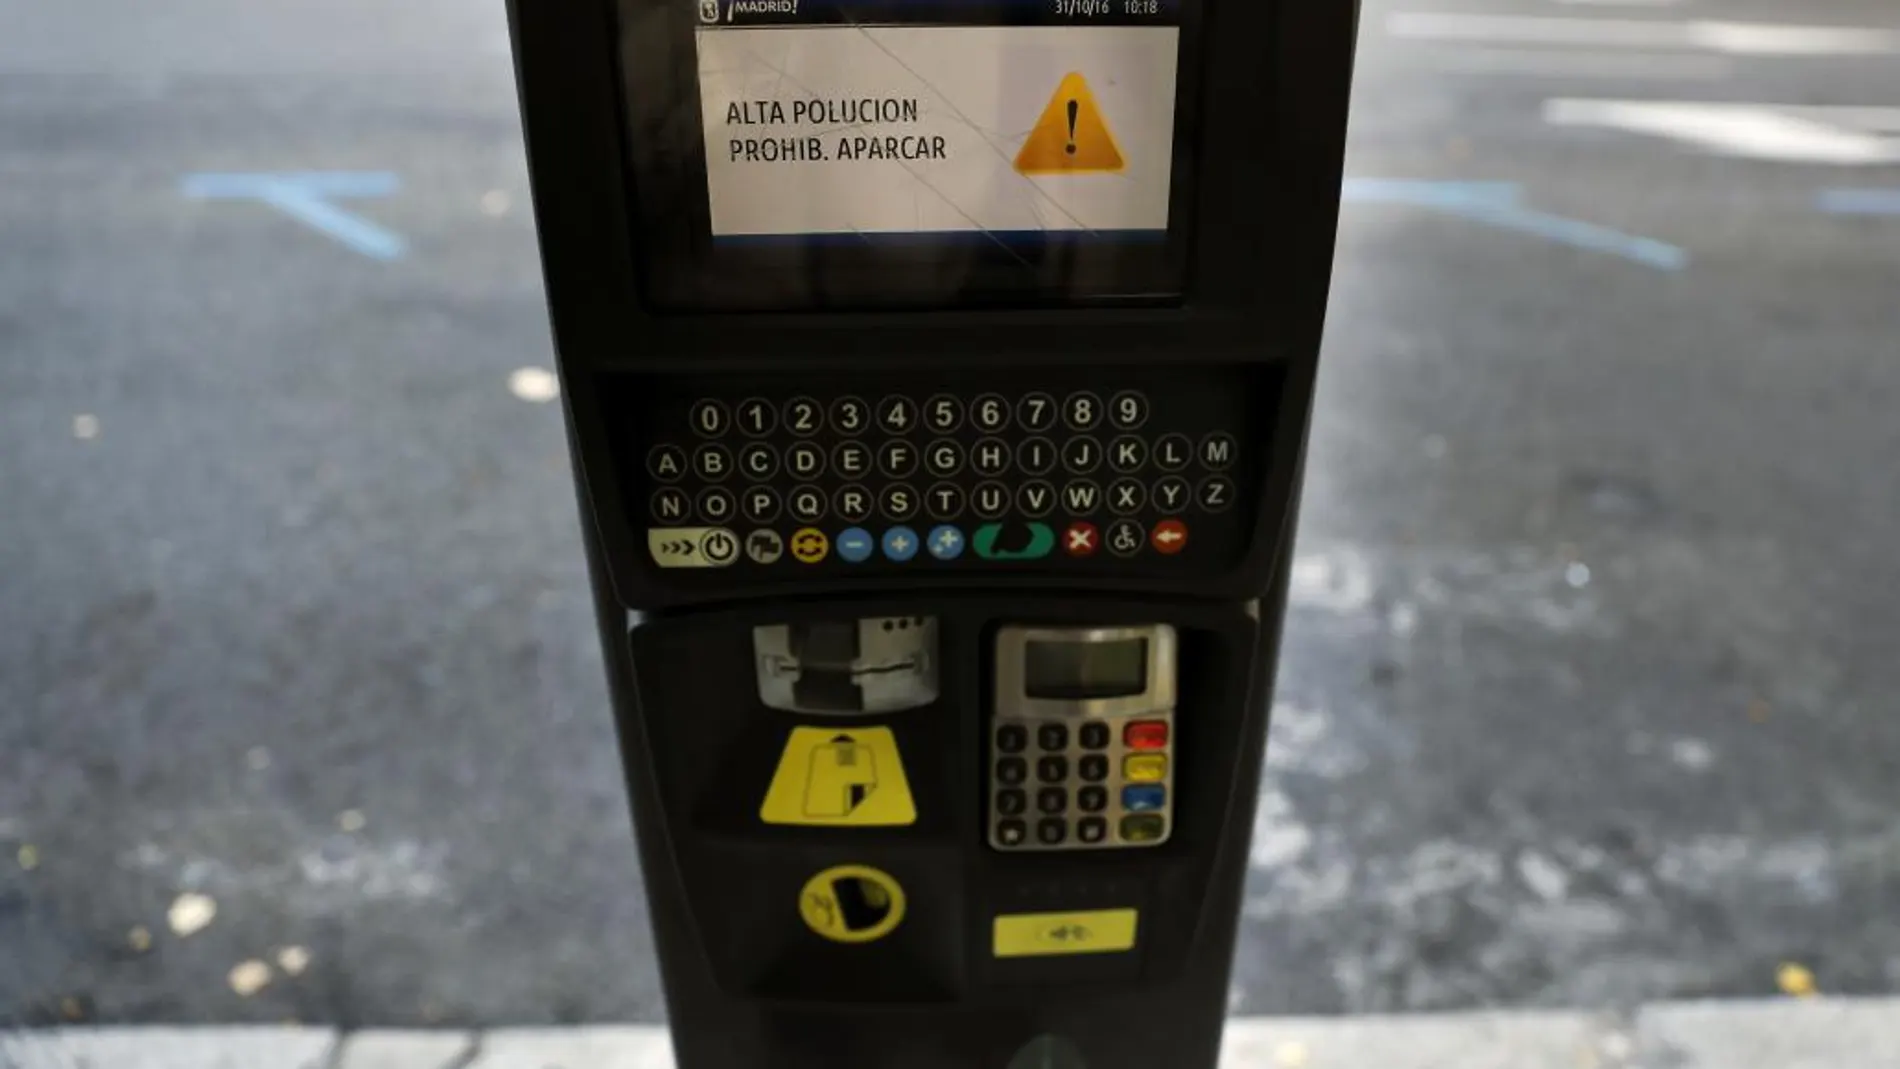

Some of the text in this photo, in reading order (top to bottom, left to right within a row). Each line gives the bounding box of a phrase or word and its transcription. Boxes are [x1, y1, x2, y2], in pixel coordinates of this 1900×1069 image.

[1055, 0, 1159, 16] 31/10/16 10:18
[726, 98, 917, 125] ALTA POLUCION
[729, 135, 946, 162] PROHIB. APARCAR
[701, 406, 719, 431] 0
[795, 404, 812, 429] 2
[842, 403, 859, 429] 3
[887, 402, 906, 427] 4
[936, 401, 953, 427] 5
[982, 400, 999, 425] 6
[1028, 400, 1045, 424] 7
[1074, 399, 1092, 424] 8
[1120, 398, 1137, 423] 9
[659, 453, 678, 473] A
[704, 452, 723, 473] B
[750, 451, 768, 472] C
[796, 450, 815, 471] D
[843, 449, 860, 470] E
[891, 448, 905, 469] F
[934, 447, 955, 469] G
[982, 447, 1000, 467] H
[1075, 444, 1089, 466] J
[1119, 443, 1137, 464] K
[1166, 442, 1181, 463] L
[1207, 441, 1228, 461] M
[662, 483, 1224, 516] N O P Q R S T U V W X Y Z
